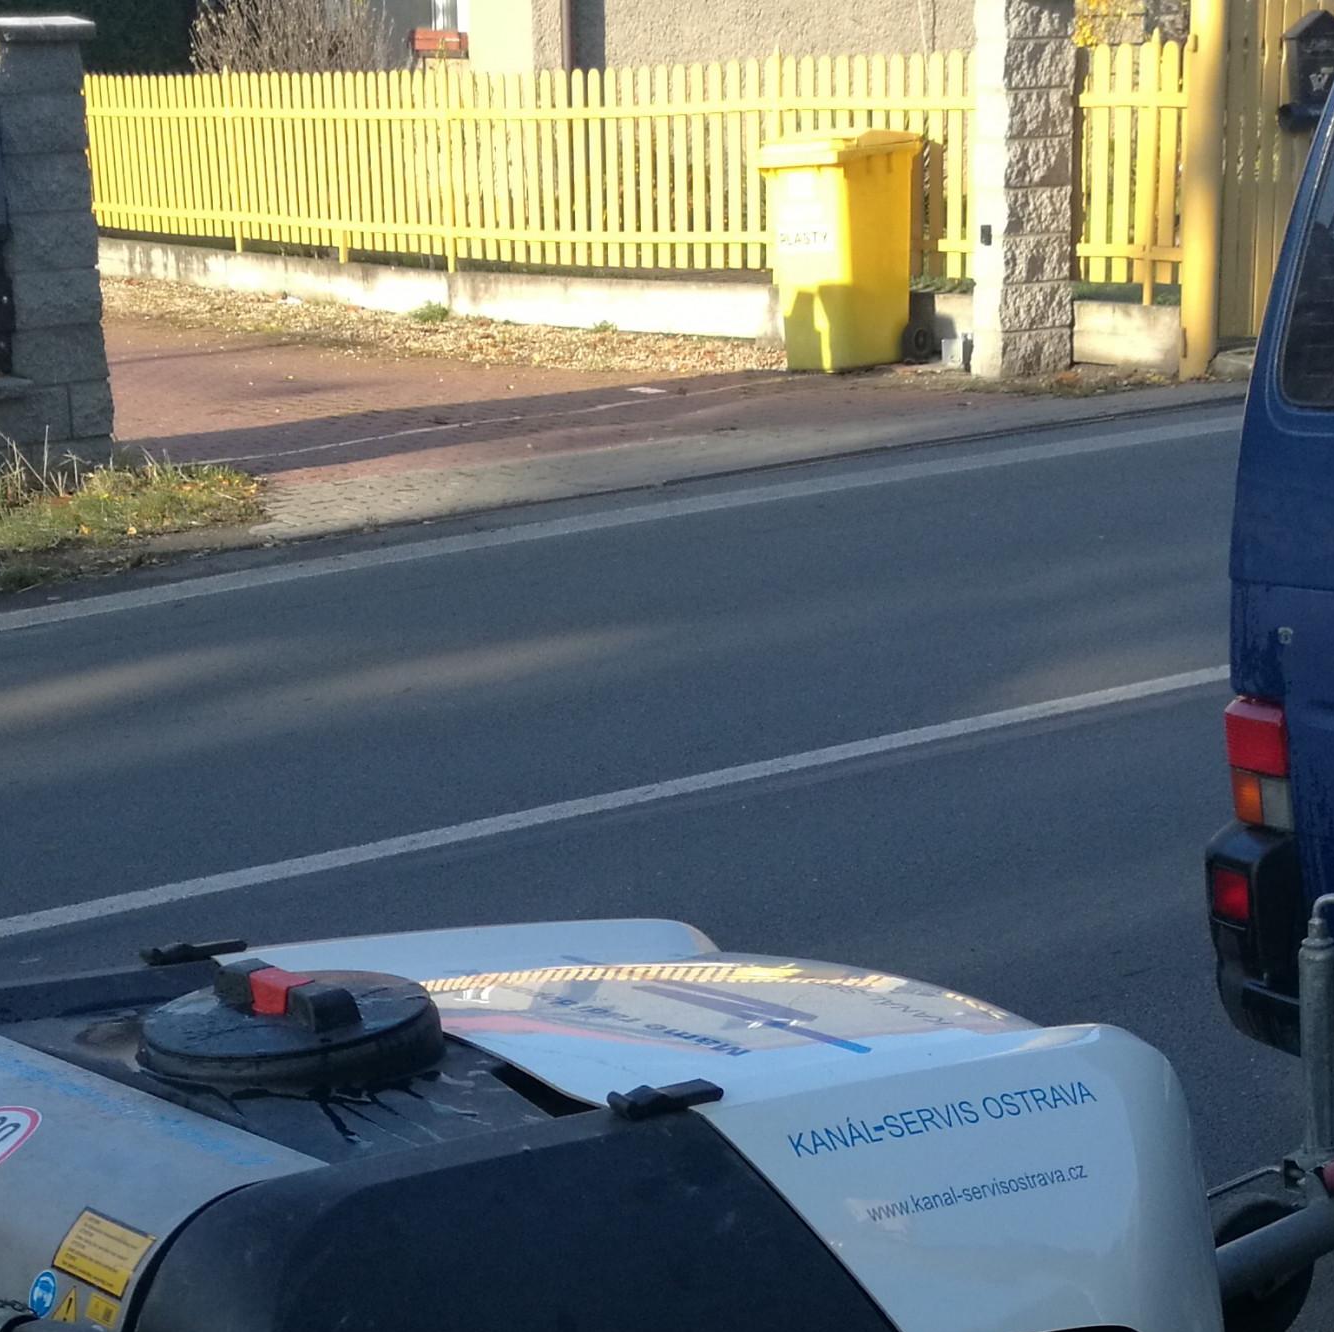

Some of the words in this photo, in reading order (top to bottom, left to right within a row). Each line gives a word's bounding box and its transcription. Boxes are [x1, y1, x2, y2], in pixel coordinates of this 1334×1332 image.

[788, 1100, 979, 1158] KANÁL-SERVIS
[982, 1081, 1098, 1120] OSTRAVA
[866, 1164, 1089, 1222] www.kanal-servisostrava.cz
